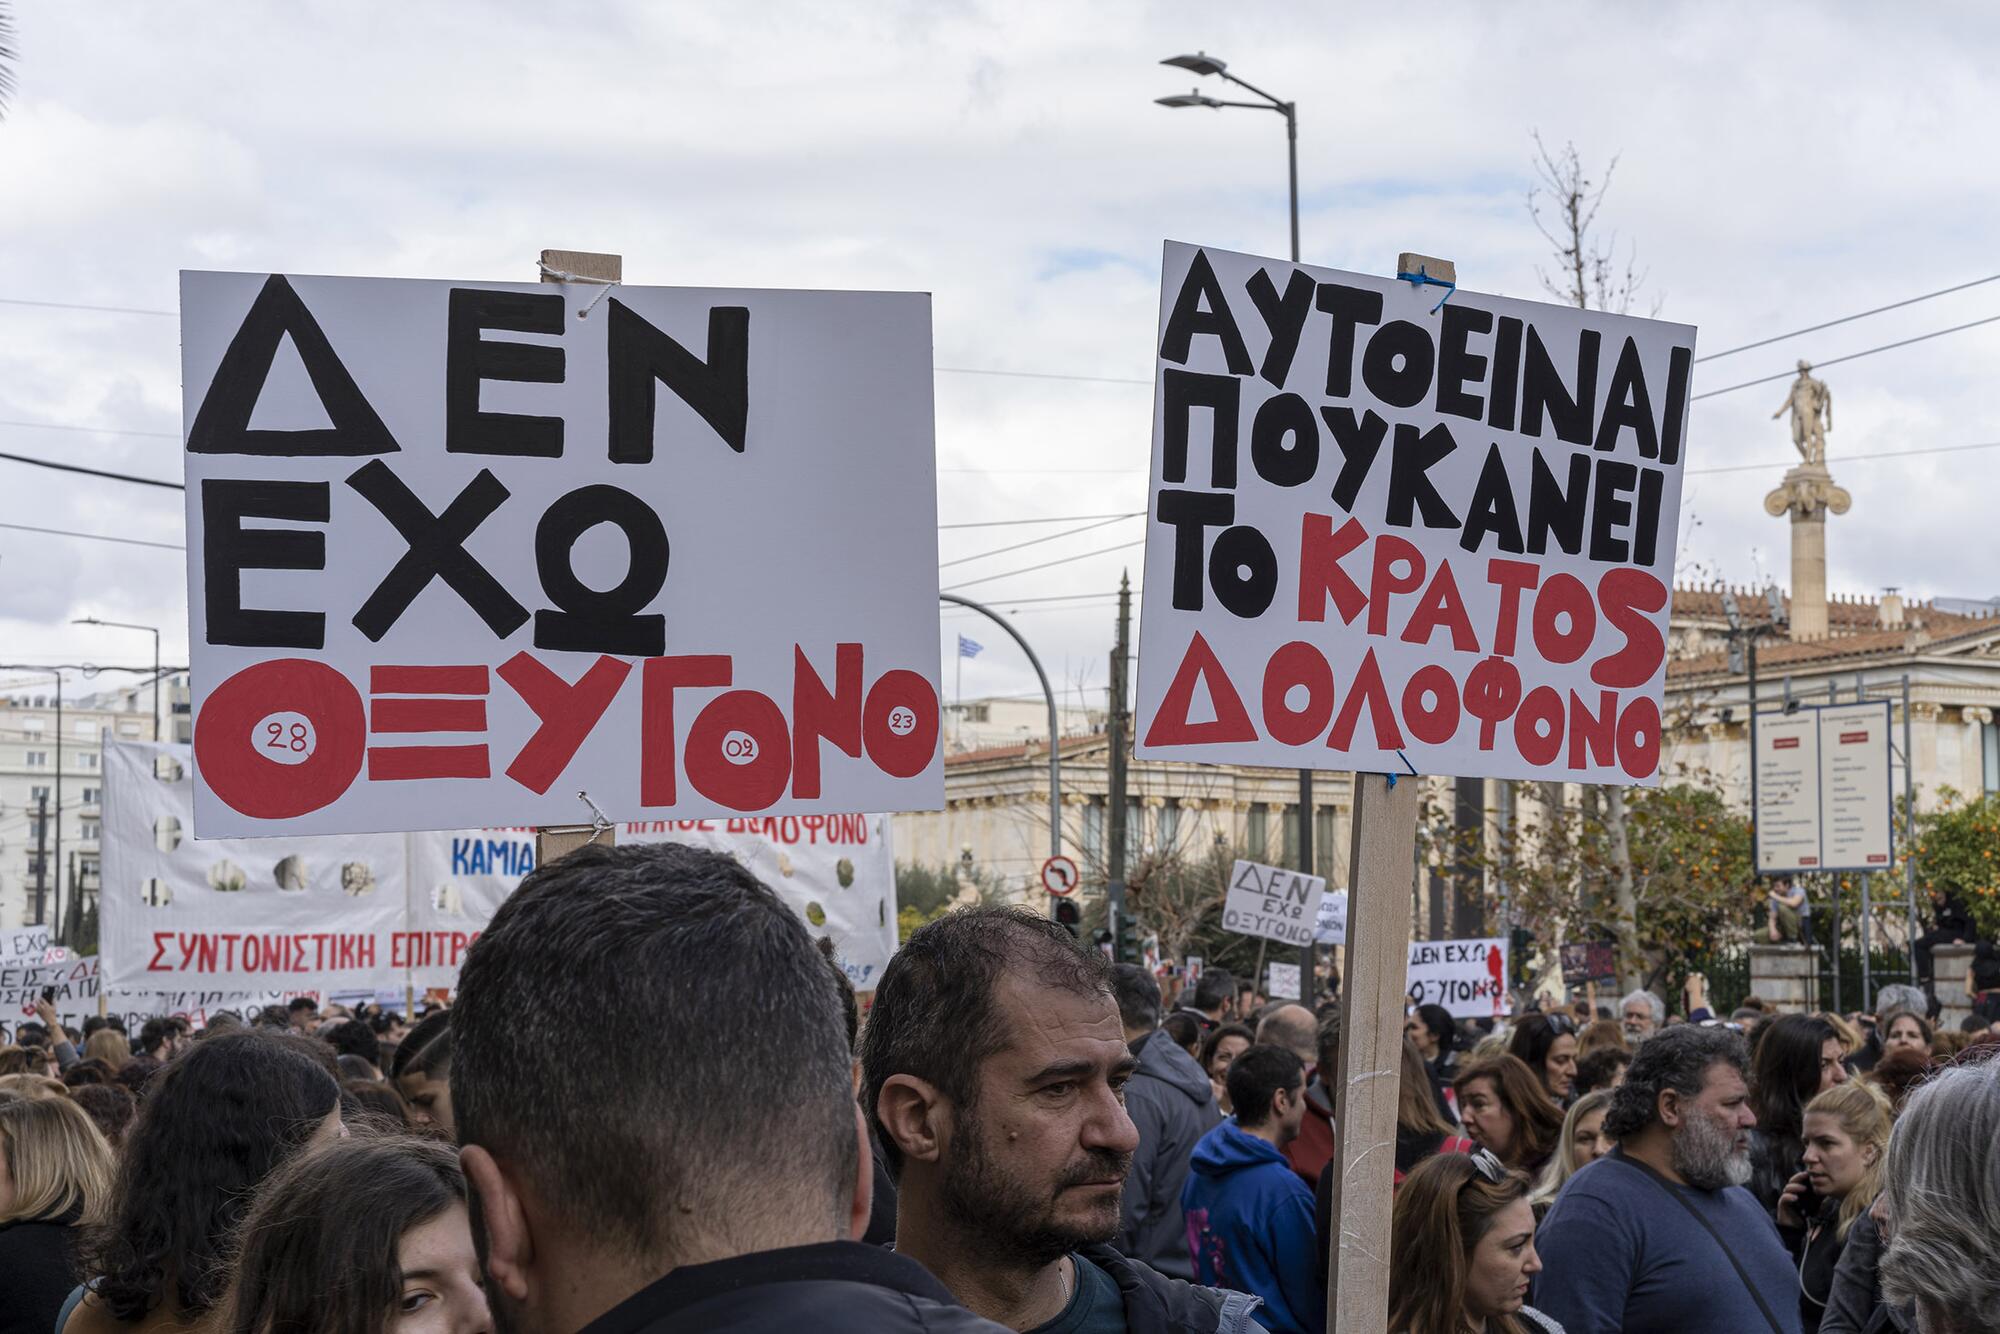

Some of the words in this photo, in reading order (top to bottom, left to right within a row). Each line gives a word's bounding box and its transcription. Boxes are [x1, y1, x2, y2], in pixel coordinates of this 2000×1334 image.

[186, 273, 750, 464] ΔΕΝ
[201, 458, 670, 657] ΕΧΩ
[1157, 489, 1279, 619] ΤΟ
[891, 712, 913, 729] 23
[1143, 630, 1662, 779] ΔΟΛΟΦΟΝΟ
[194, 643, 940, 819] ΟΞΥΓΟΝΟ
[267, 722, 307, 752] 28
[725, 738, 754, 757] 02
[451, 838, 534, 876] ΚΑΜΙΑ
[1234, 863, 1315, 905] ΔΕΝ
[1224, 909, 1312, 943] ΟΞΥΓΟΝΟ
[1262, 898, 1303, 920] ΕΧΩ
[147, 932, 375, 973] ΣΥΝΤΟΝΙΣΤΙΚΗ
[1411, 946, 1440, 966] ΔΕΝ
[1444, 943, 1488, 963] ΕΧΩ
